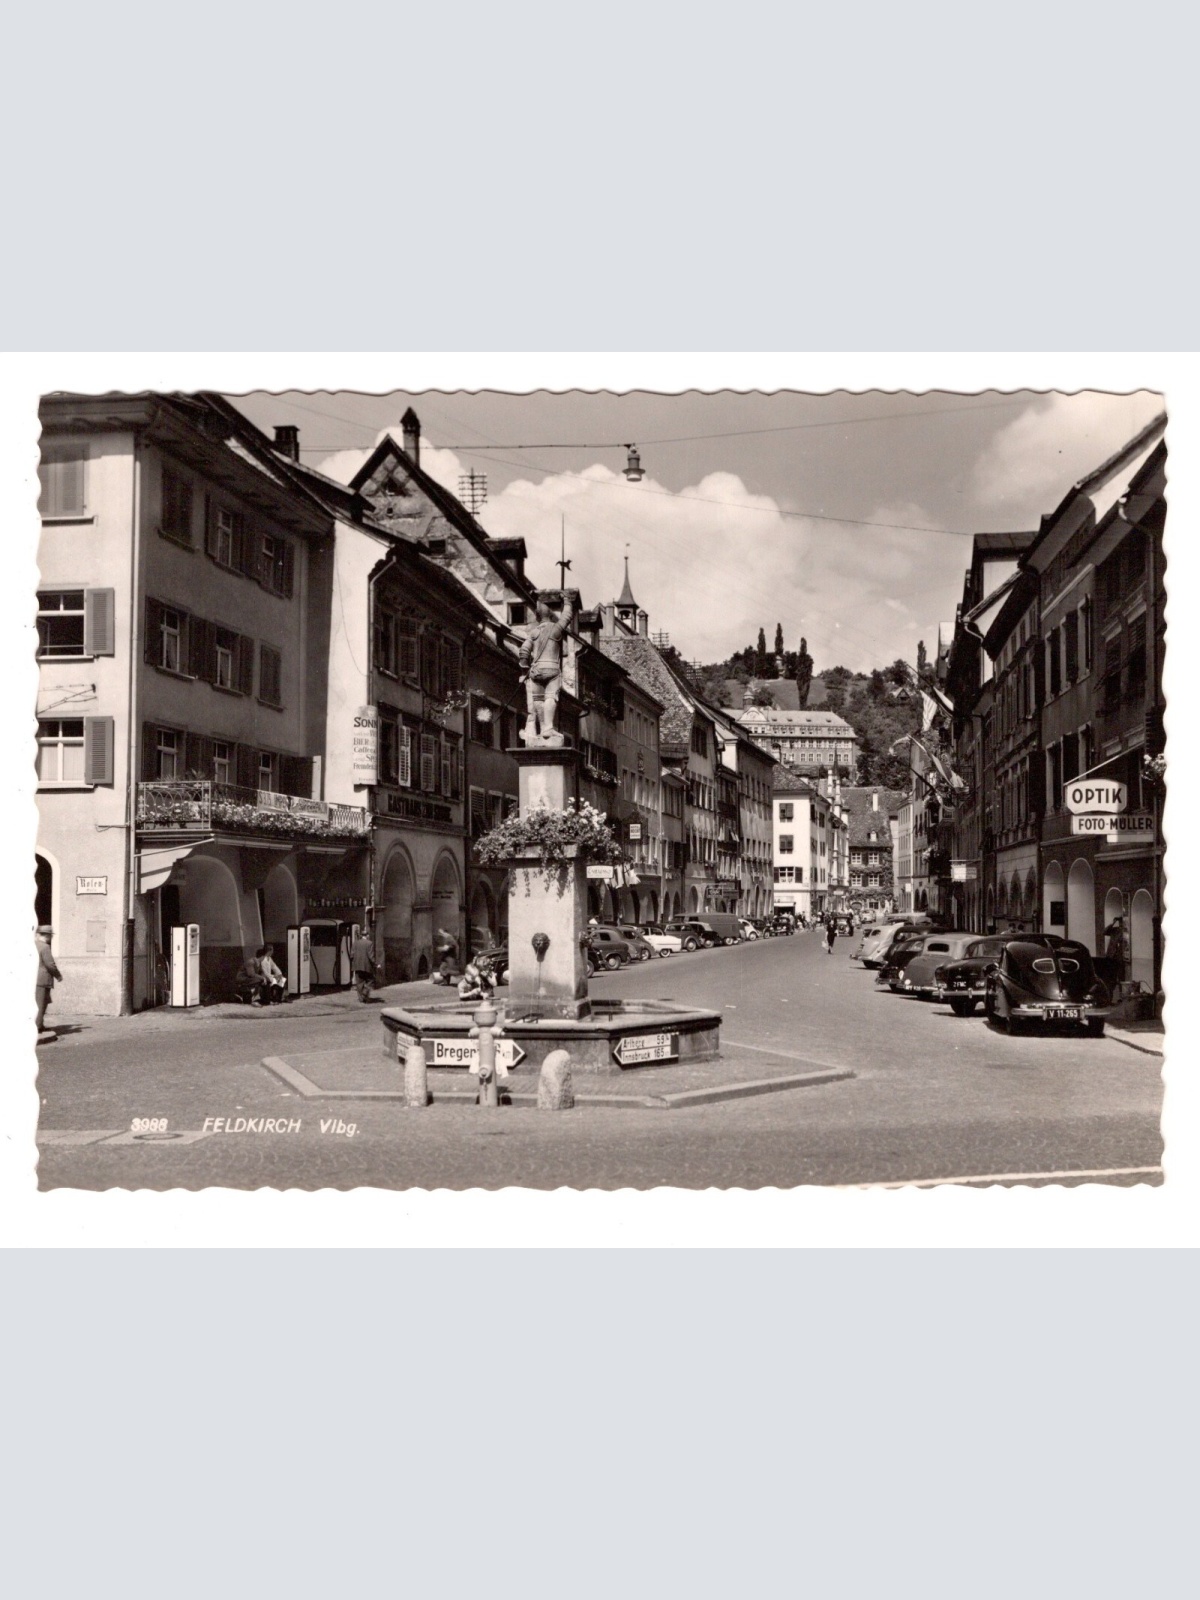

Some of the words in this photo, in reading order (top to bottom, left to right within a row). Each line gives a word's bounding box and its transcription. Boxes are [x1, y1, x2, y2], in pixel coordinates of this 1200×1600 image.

[1072, 788, 1122, 804] OPTIK
[1049, 1010, 1054, 1018] V
[656, 1034, 664, 1044] 59
[623, 1051, 650, 1062] Innsbruck
[654, 1048, 664, 1058] 165
